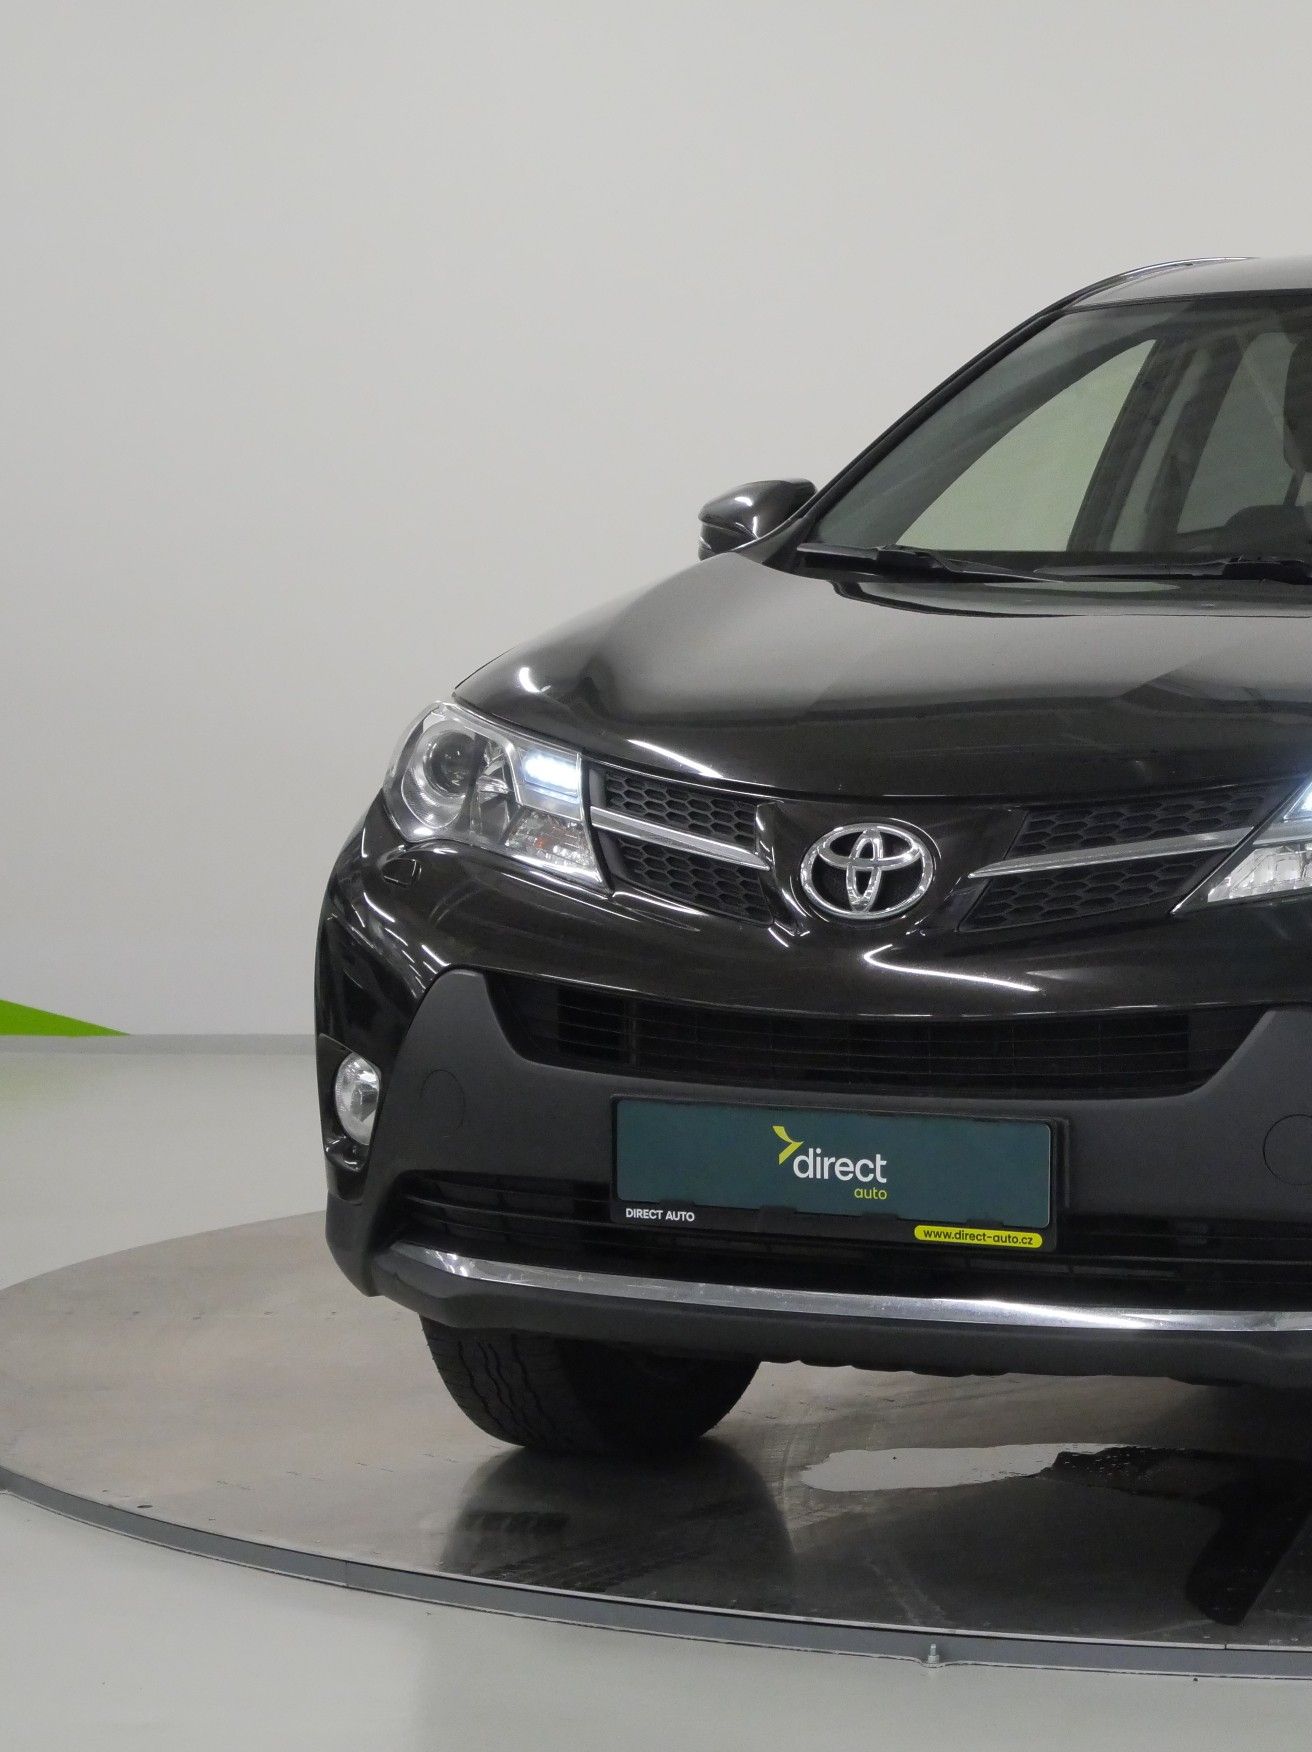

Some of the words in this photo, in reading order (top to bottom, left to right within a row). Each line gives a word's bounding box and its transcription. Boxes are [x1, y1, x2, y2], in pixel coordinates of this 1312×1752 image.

[793, 1147, 887, 1183] direct
[854, 1186, 887, 1200] auto
[625, 1208, 663, 1220] DIRECT
[665, 1209, 695, 1221] AUTO
[923, 1229, 1034, 1245] www.direct-auto.cz
